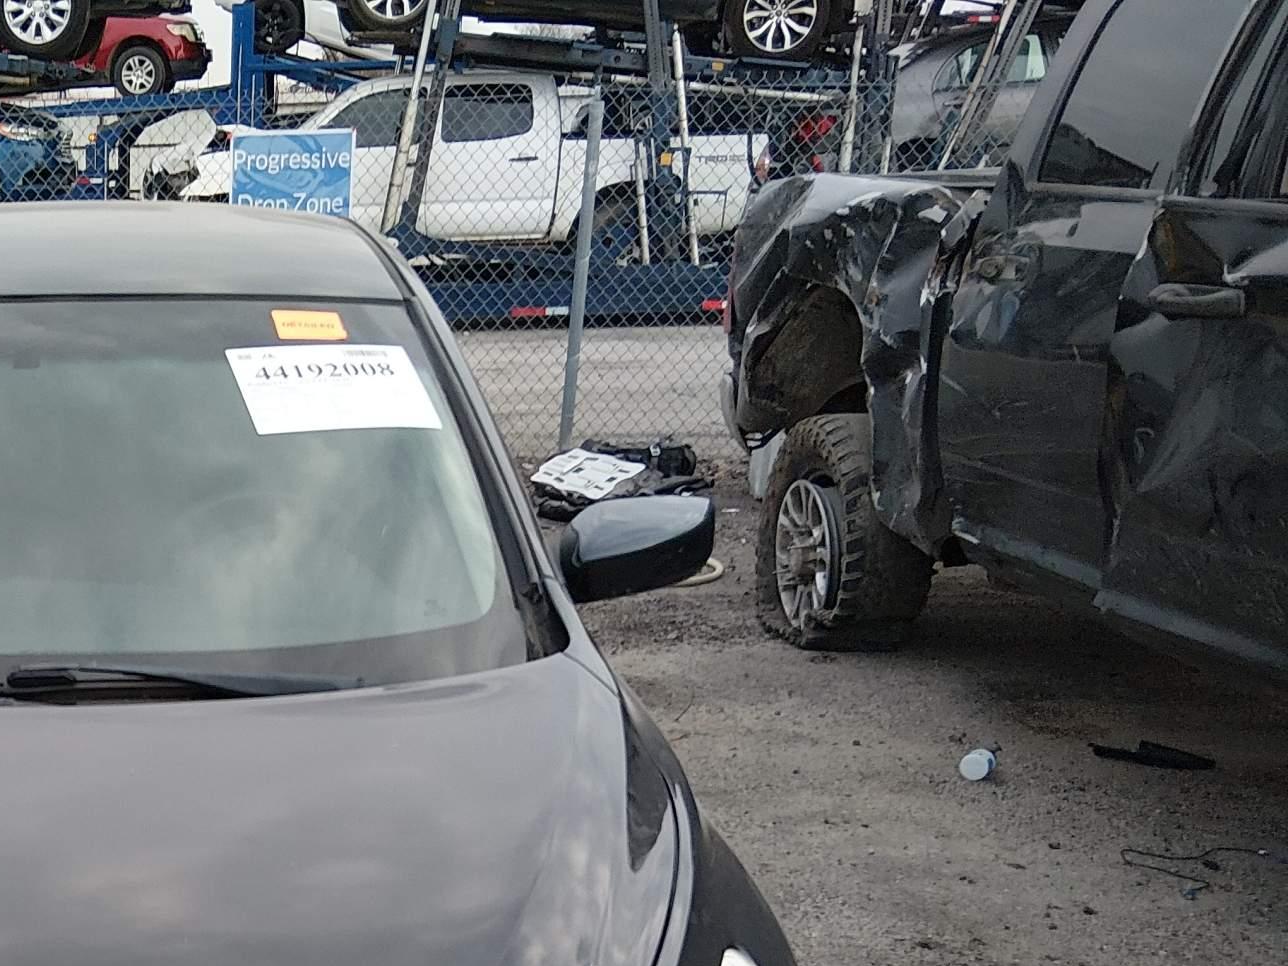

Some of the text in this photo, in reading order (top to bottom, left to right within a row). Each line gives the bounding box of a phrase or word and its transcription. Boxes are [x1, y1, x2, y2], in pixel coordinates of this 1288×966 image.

[233, 147, 350, 174] Progressive
[293, 192, 344, 213] Zone
[255, 363, 395, 380] 44192008
